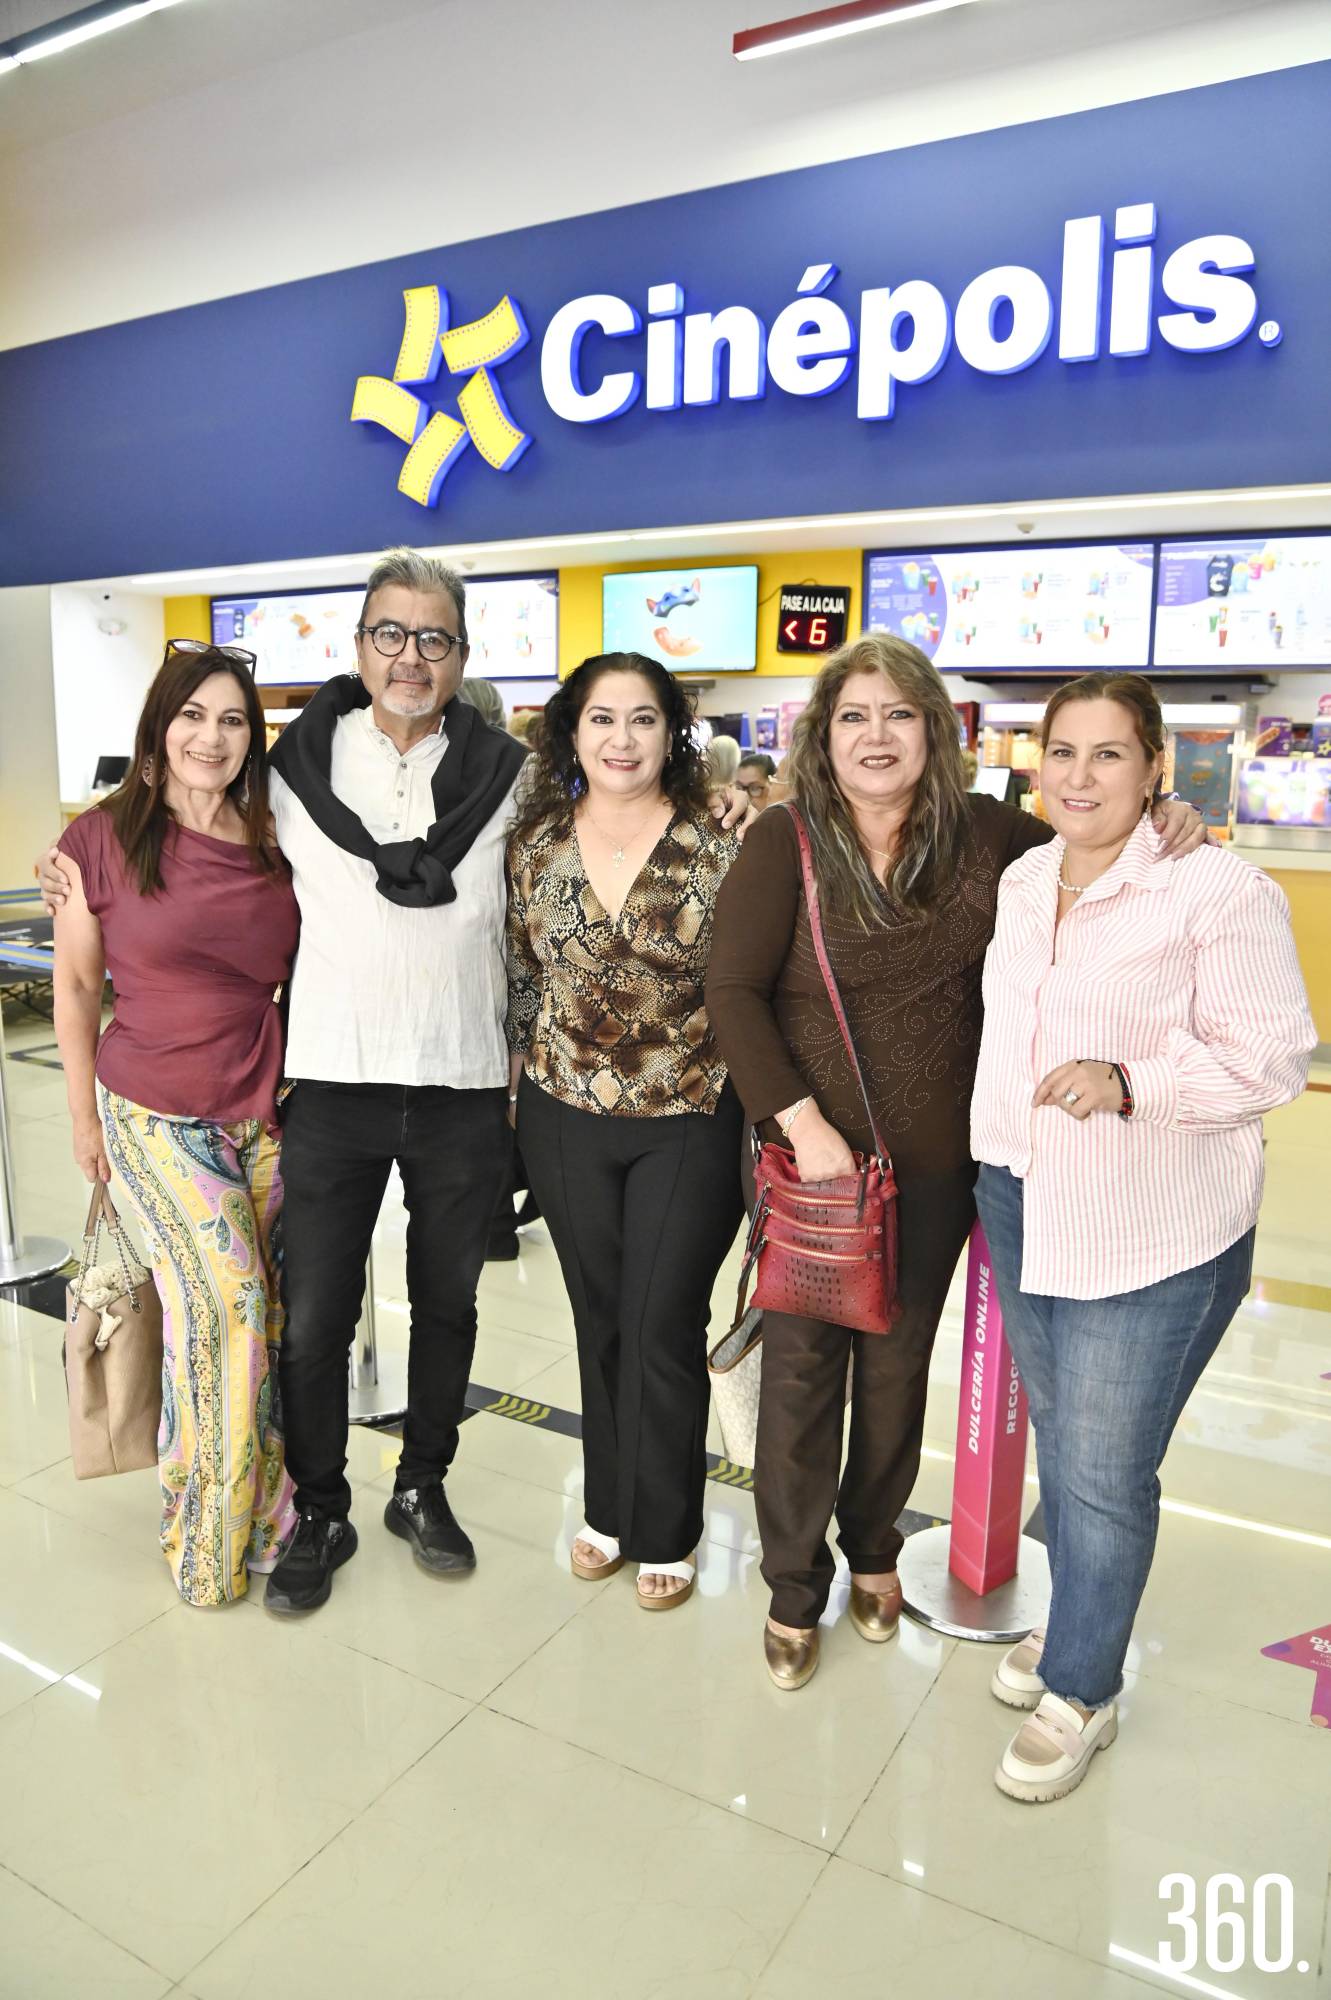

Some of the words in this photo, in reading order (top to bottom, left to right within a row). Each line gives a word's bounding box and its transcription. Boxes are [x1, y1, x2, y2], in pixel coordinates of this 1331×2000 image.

[781, 595, 803, 611] PASE
[803, 596, 810, 612] A
[810, 596, 822, 613] LA
[822, 596, 845, 613] CAJA
[809, 618, 827, 645] 6
[976, 1262, 990, 1344] ONLINE
[968, 1351, 985, 1455] DULCERÍA
[1006, 1354, 1019, 1434] RECOG
